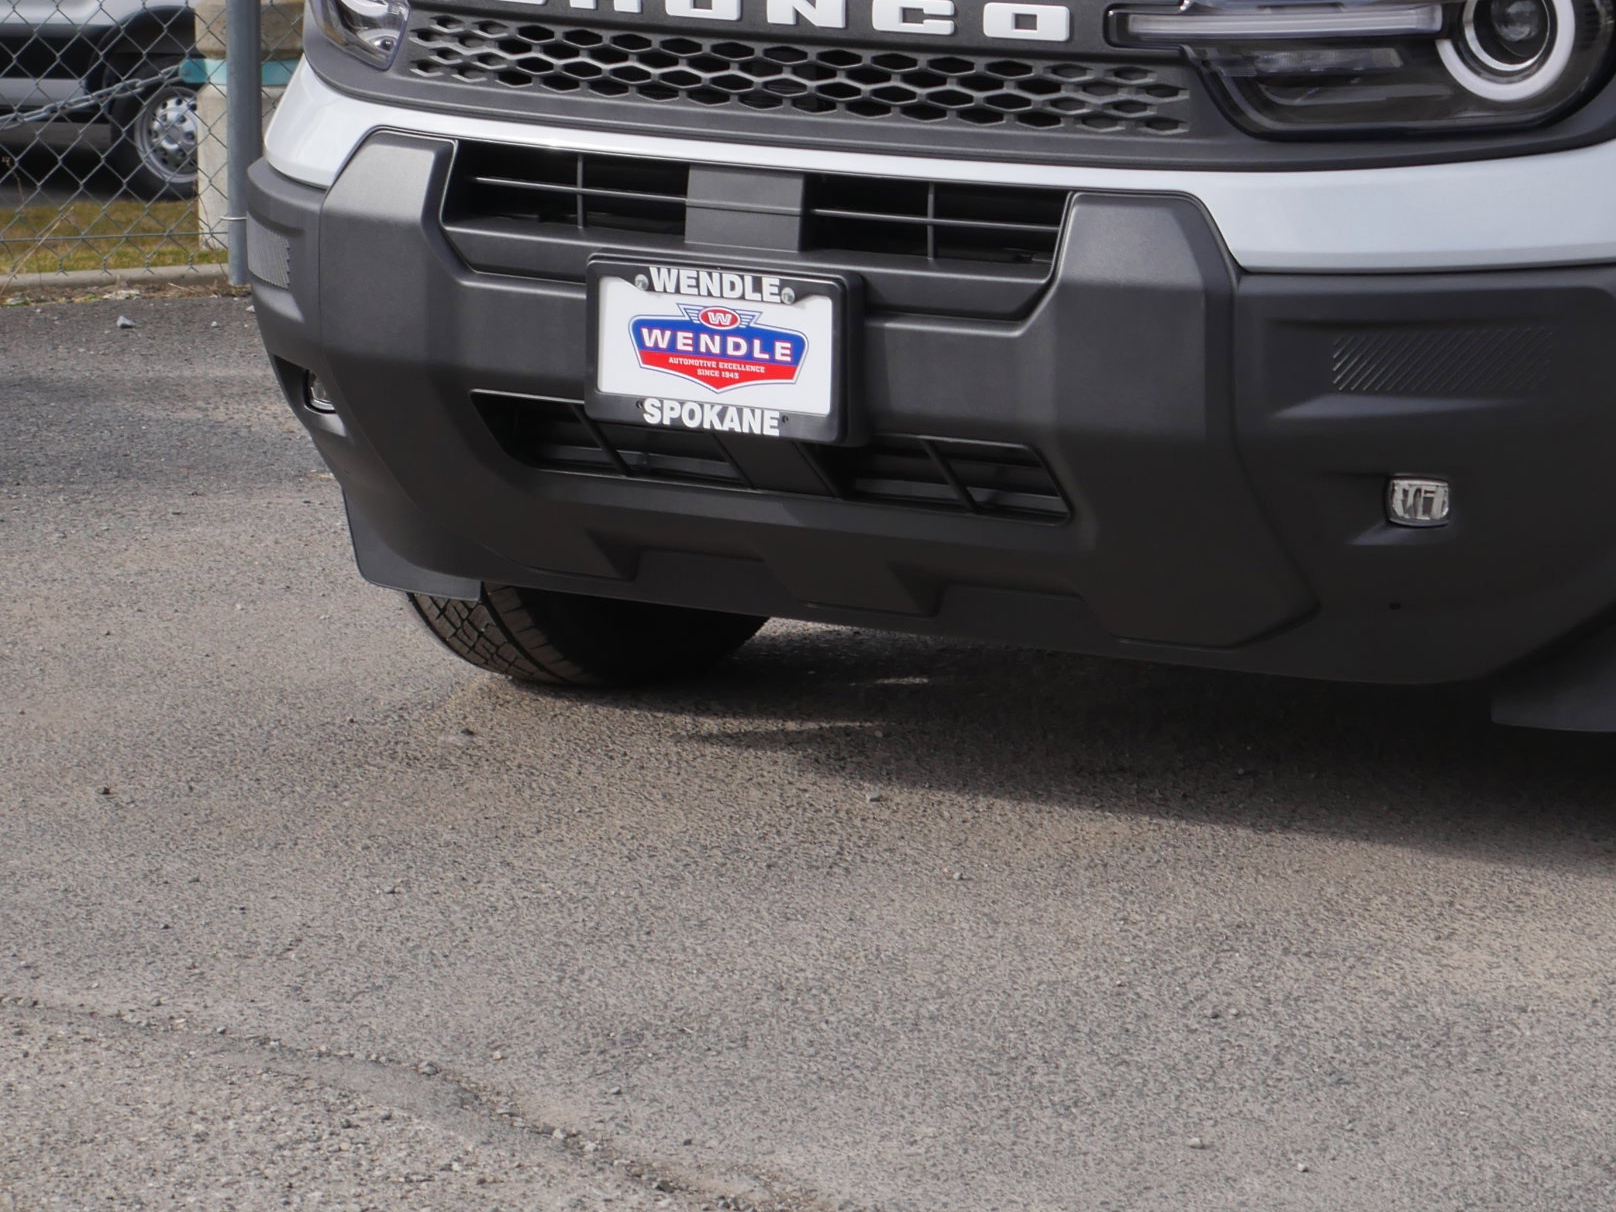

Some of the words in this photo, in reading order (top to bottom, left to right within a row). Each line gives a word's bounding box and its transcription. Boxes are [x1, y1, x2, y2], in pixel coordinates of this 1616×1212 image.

[650, 267, 782, 303] WENDLE
[641, 328, 792, 362] WENDLE
[669, 357, 717, 368] AUTOMOTIVE
[719, 361, 766, 373] EXCELLENCE
[697, 369, 720, 378] SINCE
[643, 398, 780, 436] SPOKANE
